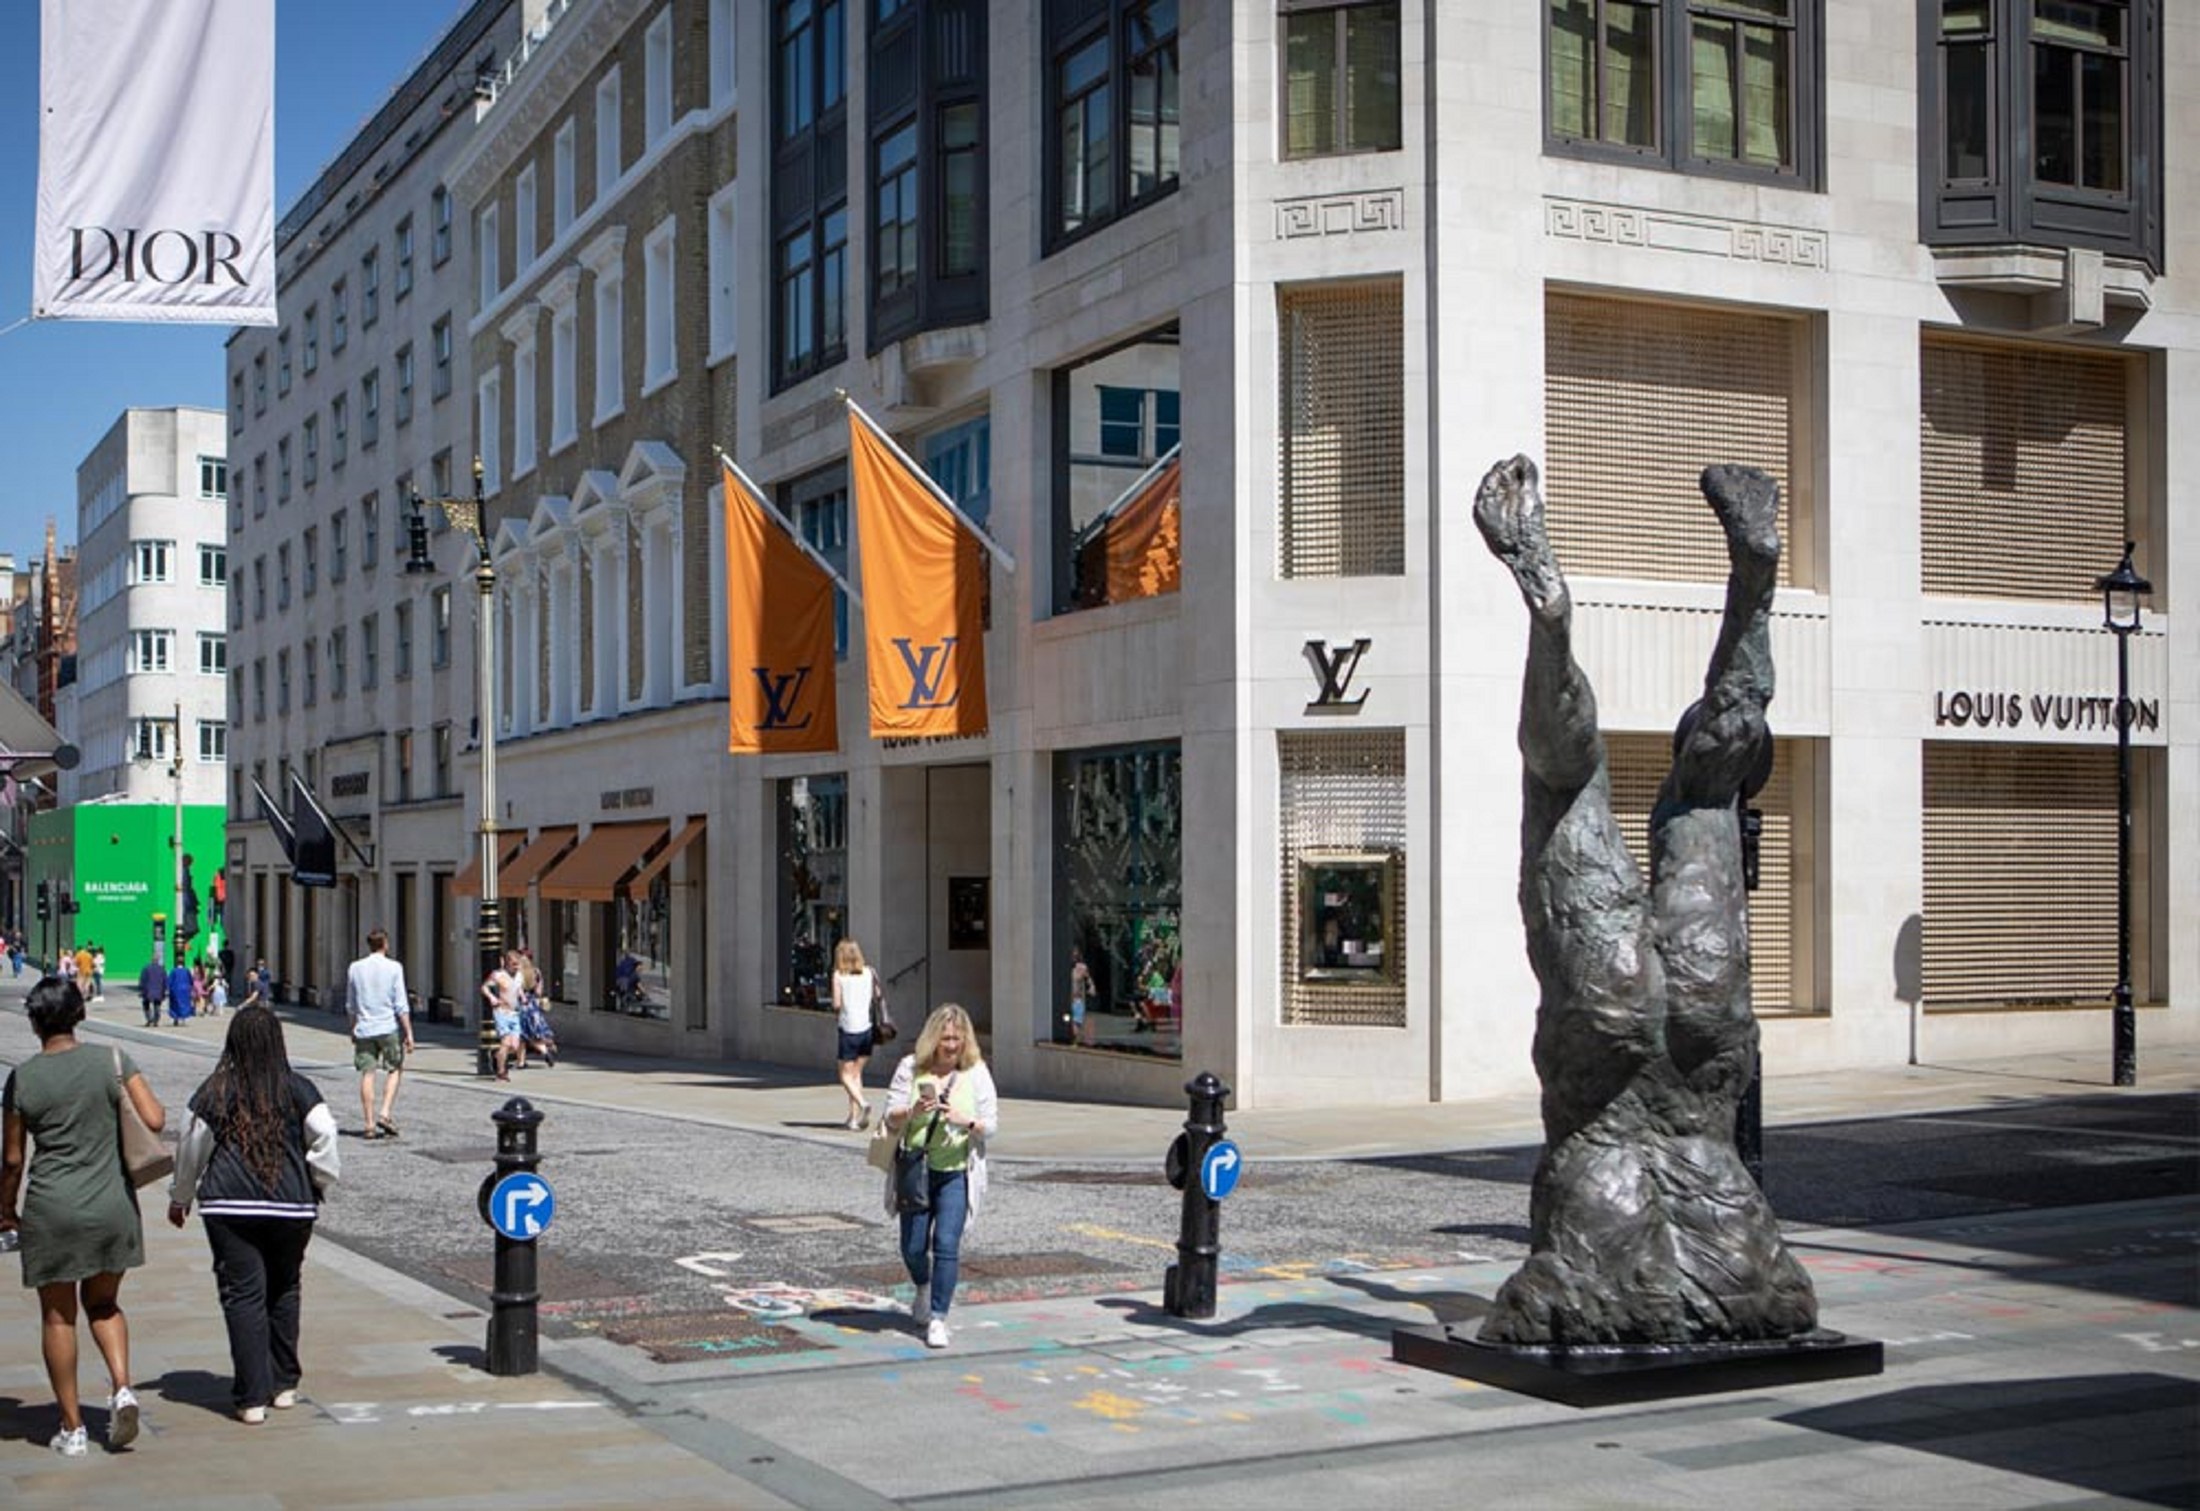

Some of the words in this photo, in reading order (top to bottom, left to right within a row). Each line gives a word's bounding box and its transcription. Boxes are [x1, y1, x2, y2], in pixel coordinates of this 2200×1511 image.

[68, 226, 249, 287] DIOR
[1935, 691, 2022, 728] LOUIS
[84, 881, 149, 894] BALENCIAGA
